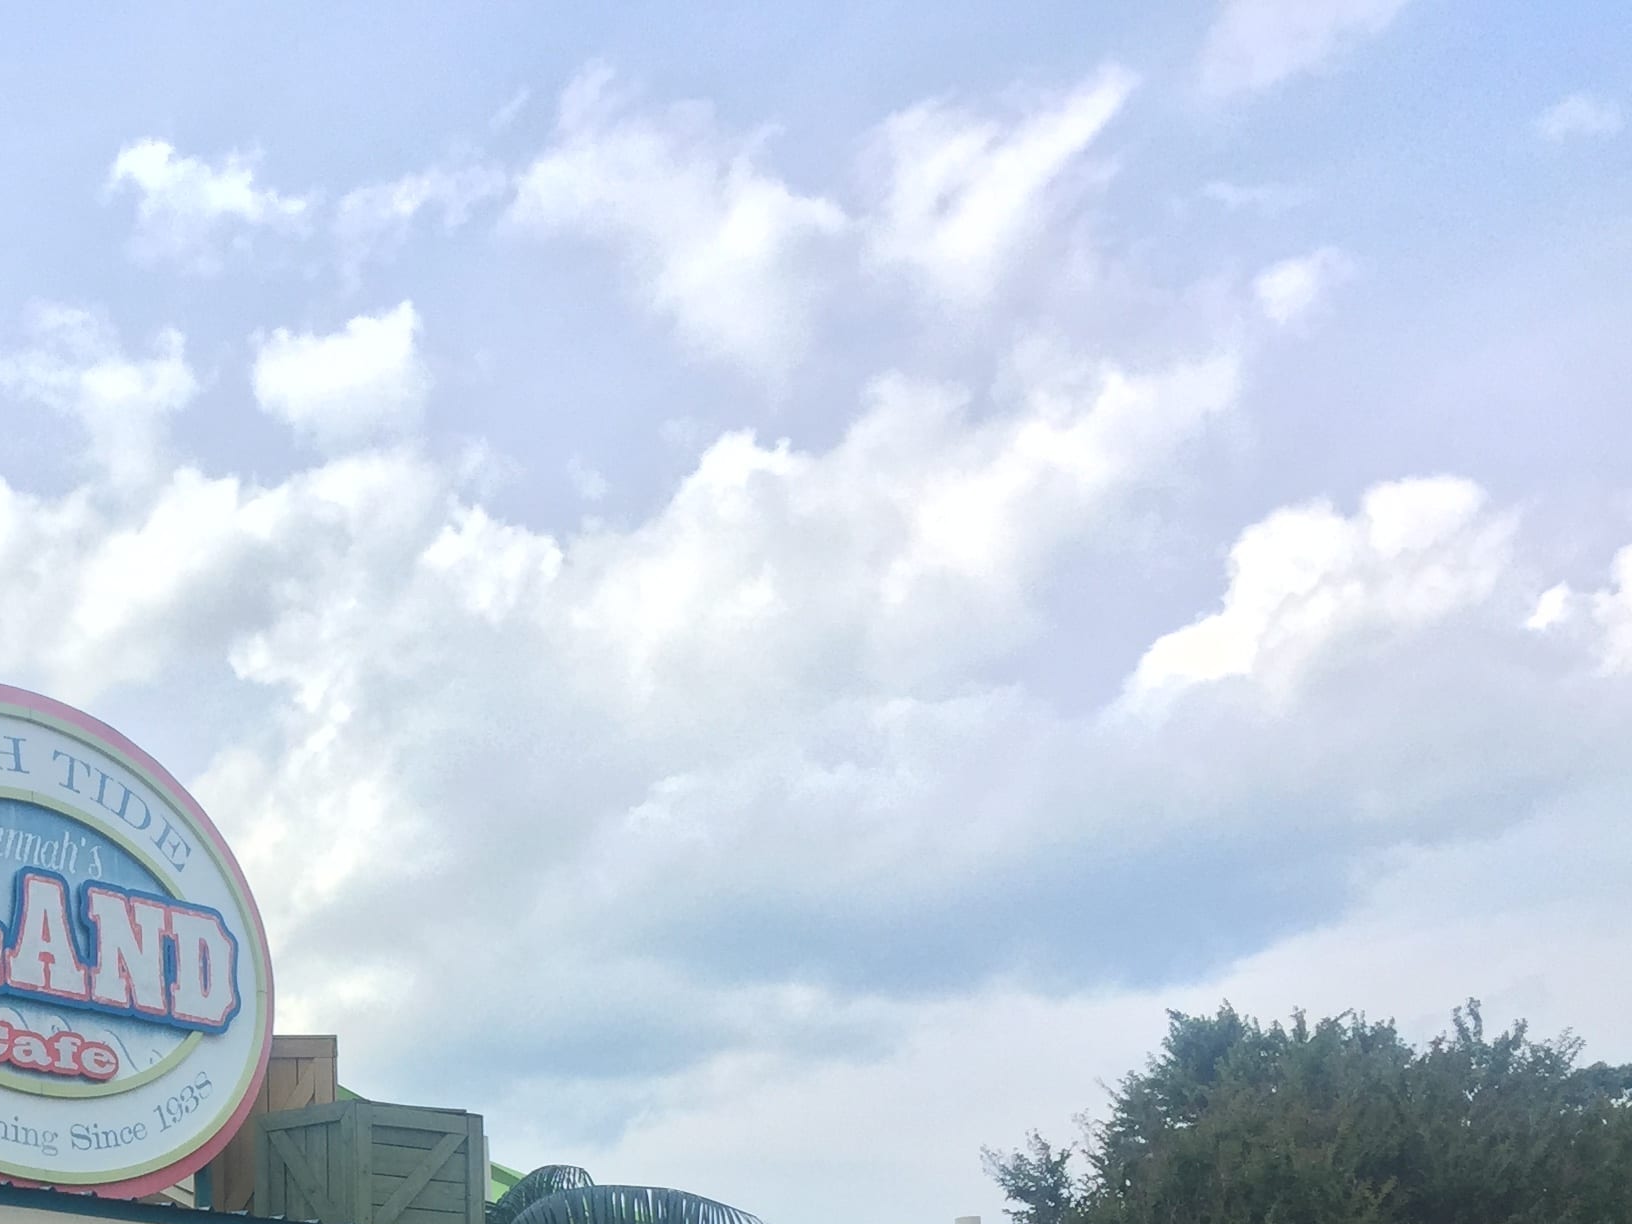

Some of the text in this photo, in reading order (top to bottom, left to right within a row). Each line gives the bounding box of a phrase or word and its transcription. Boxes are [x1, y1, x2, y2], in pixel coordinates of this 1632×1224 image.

[52, 748, 194, 873] TIDE
[70, 1121, 148, 1153] Since
[153, 1070, 215, 1132] 1938
